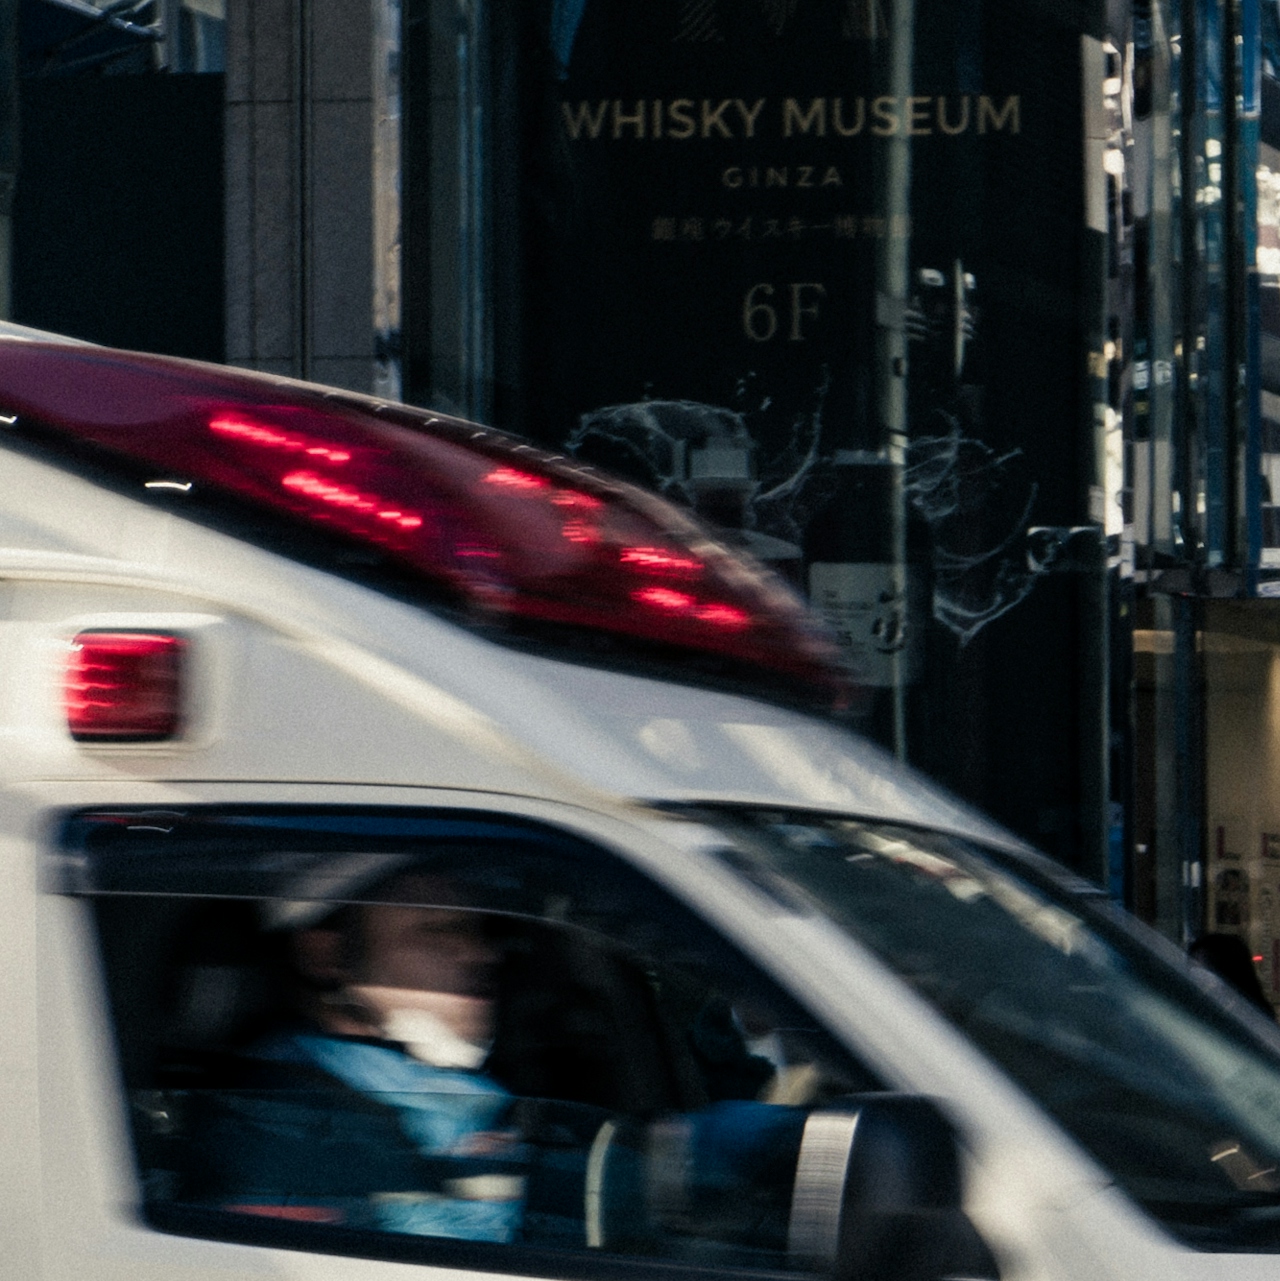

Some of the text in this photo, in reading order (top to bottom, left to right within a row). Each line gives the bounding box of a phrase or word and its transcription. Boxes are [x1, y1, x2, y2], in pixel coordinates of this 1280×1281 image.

[561, 94, 1021, 141] WHISKY MUSEUM
[722, 166, 844, 188] GINZA
[742, 282, 829, 343] 6F
